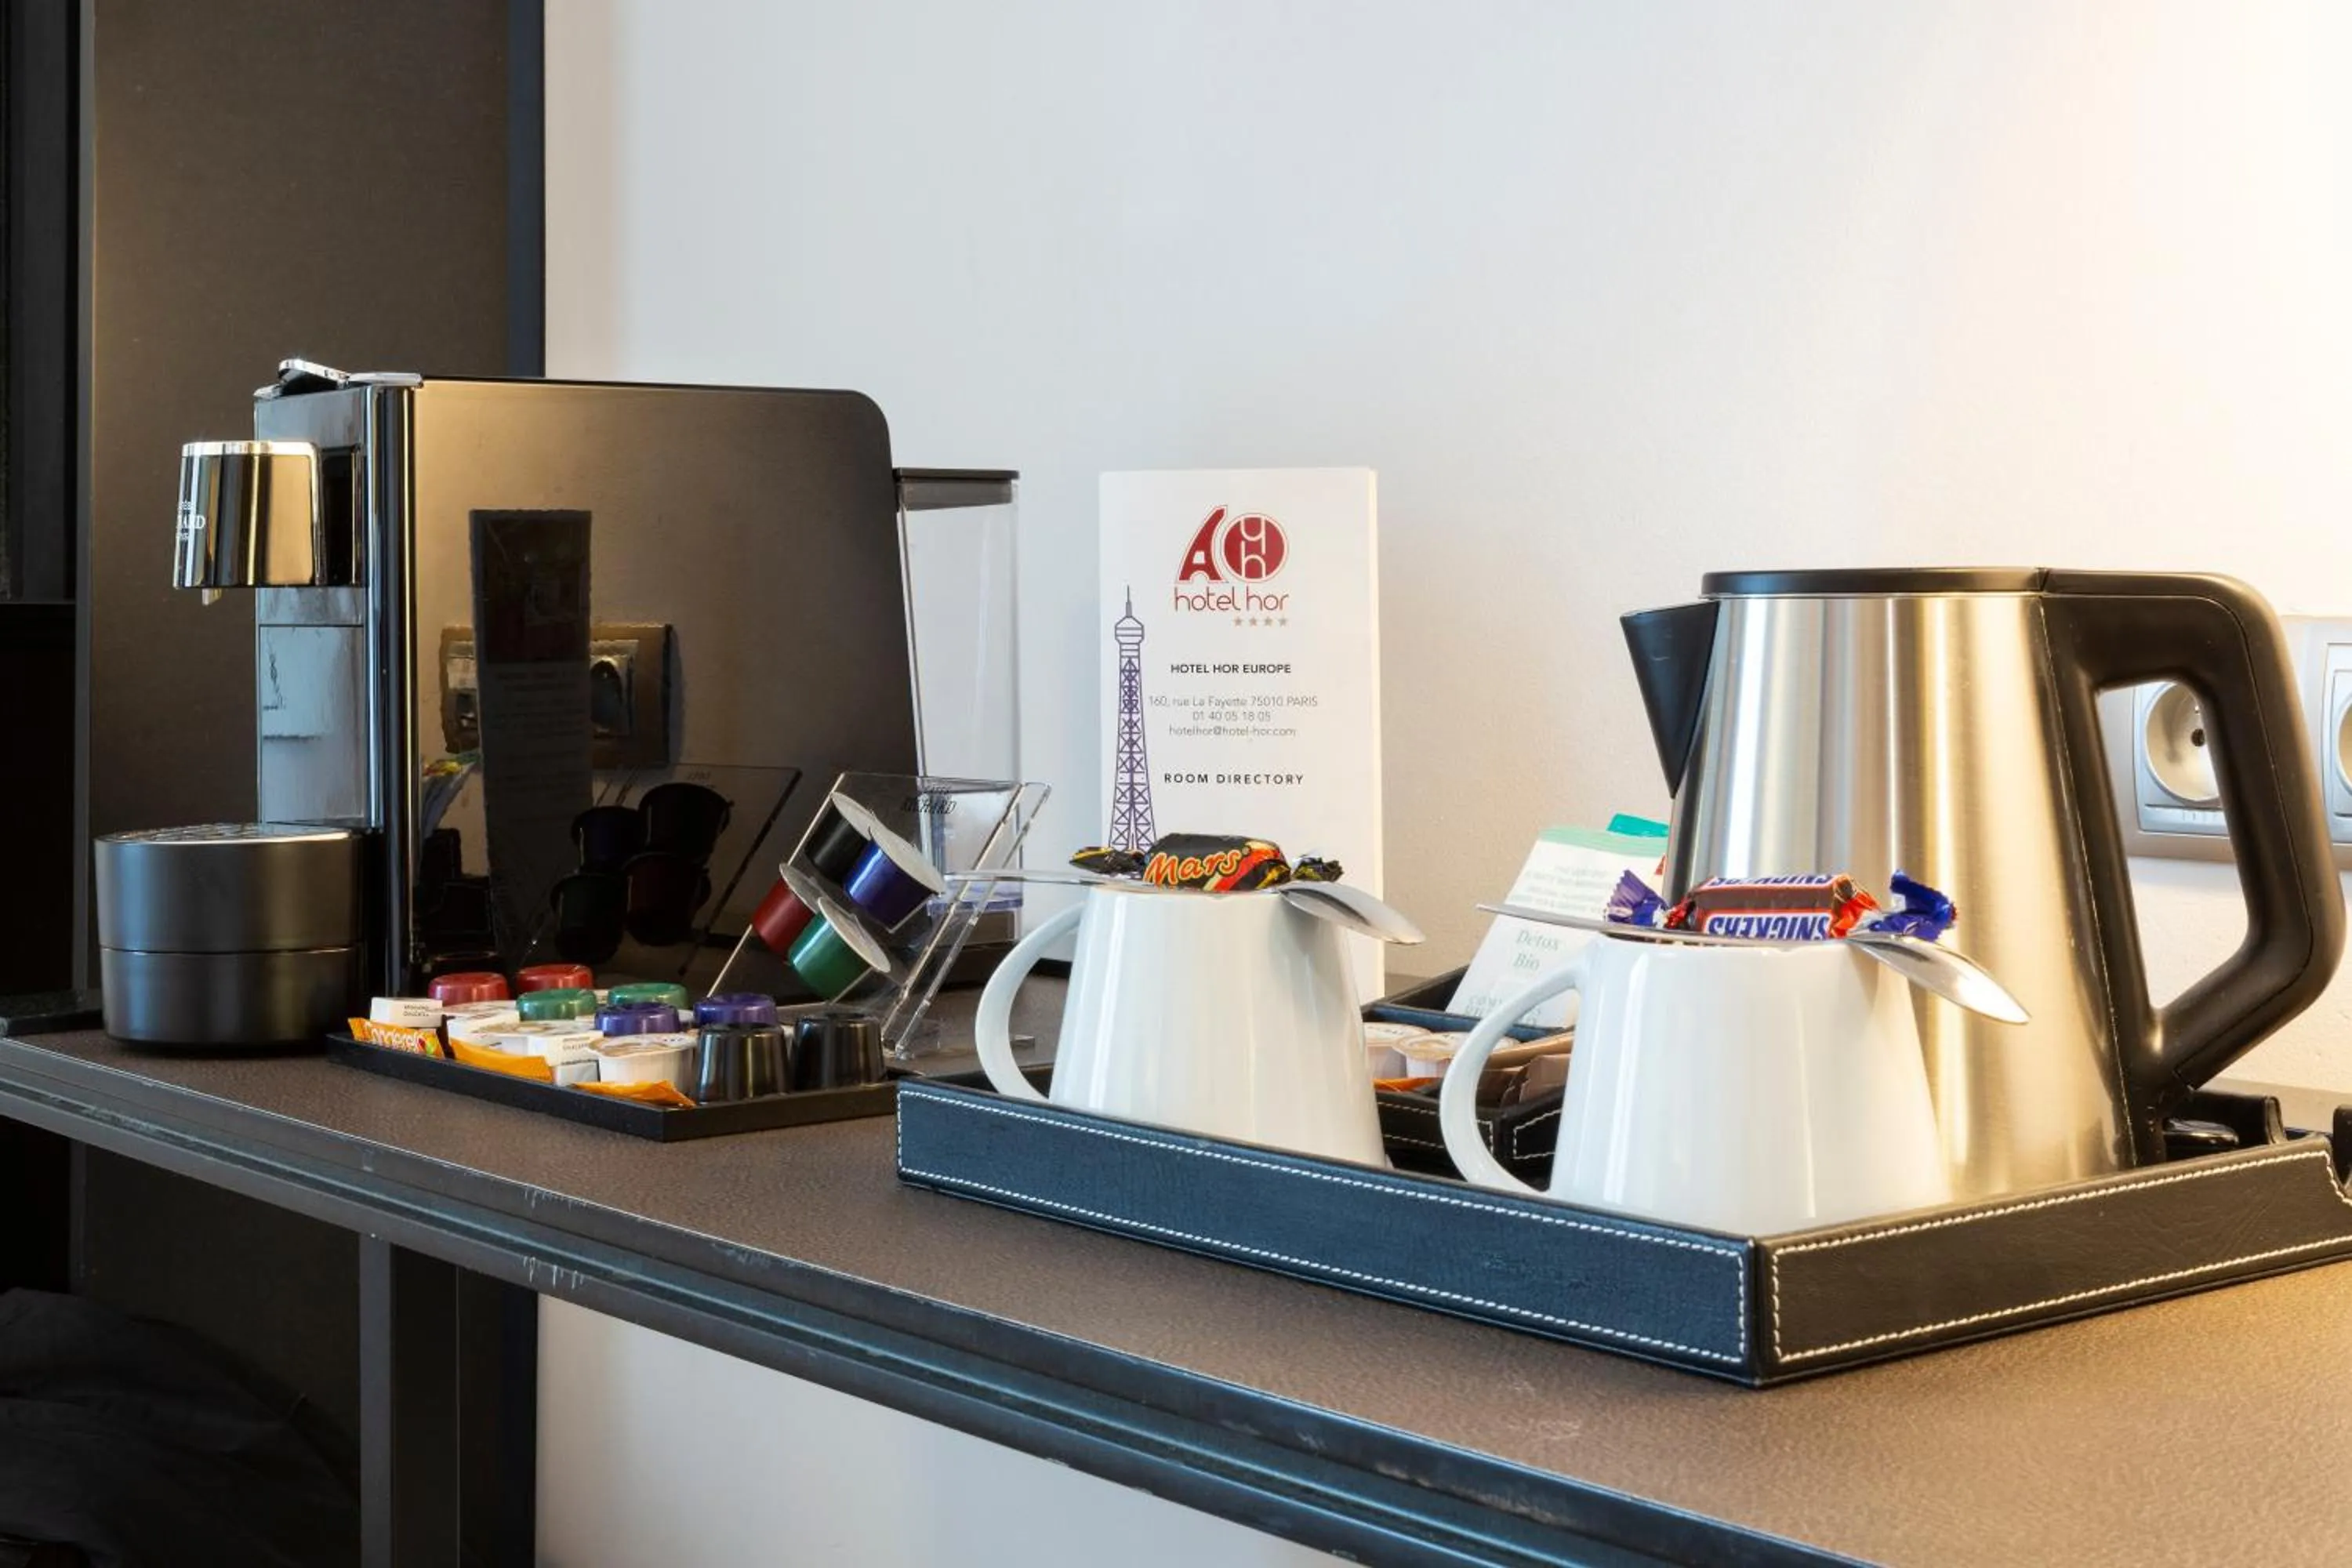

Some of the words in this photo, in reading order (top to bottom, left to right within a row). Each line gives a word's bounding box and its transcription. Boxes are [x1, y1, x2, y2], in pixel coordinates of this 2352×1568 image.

[1174, 586, 1241, 612] hotel
[1246, 586, 1290, 612] hor
[1171, 664, 1210, 674] HOTEL
[1213, 664, 1240, 674] HOR
[1243, 664, 1291, 674] EUROPE
[1149, 695, 1168, 708] 160,
[1173, 698, 1189, 706] rue
[1192, 696, 1205, 706] La
[1208, 696, 1247, 710] Fayette
[1251, 696, 1283, 706] 75010
[1287, 696, 1318, 706] PARIS
[1192, 711, 1204, 721] 01
[1208, 711, 1222, 721] 40
[1225, 711, 1238, 721] 05
[1243, 711, 1255, 721] 18
[1257, 711, 1271, 722] 05
[1169, 724, 1297, 736] hotelhor@hotel-hor.com
[1163, 773, 1209, 784] ROOM
[1216, 774, 1304, 785] DIRECTORY
[1708, 916, 1831, 940] SNICKERS
[1513, 953, 1541, 971] Bio
